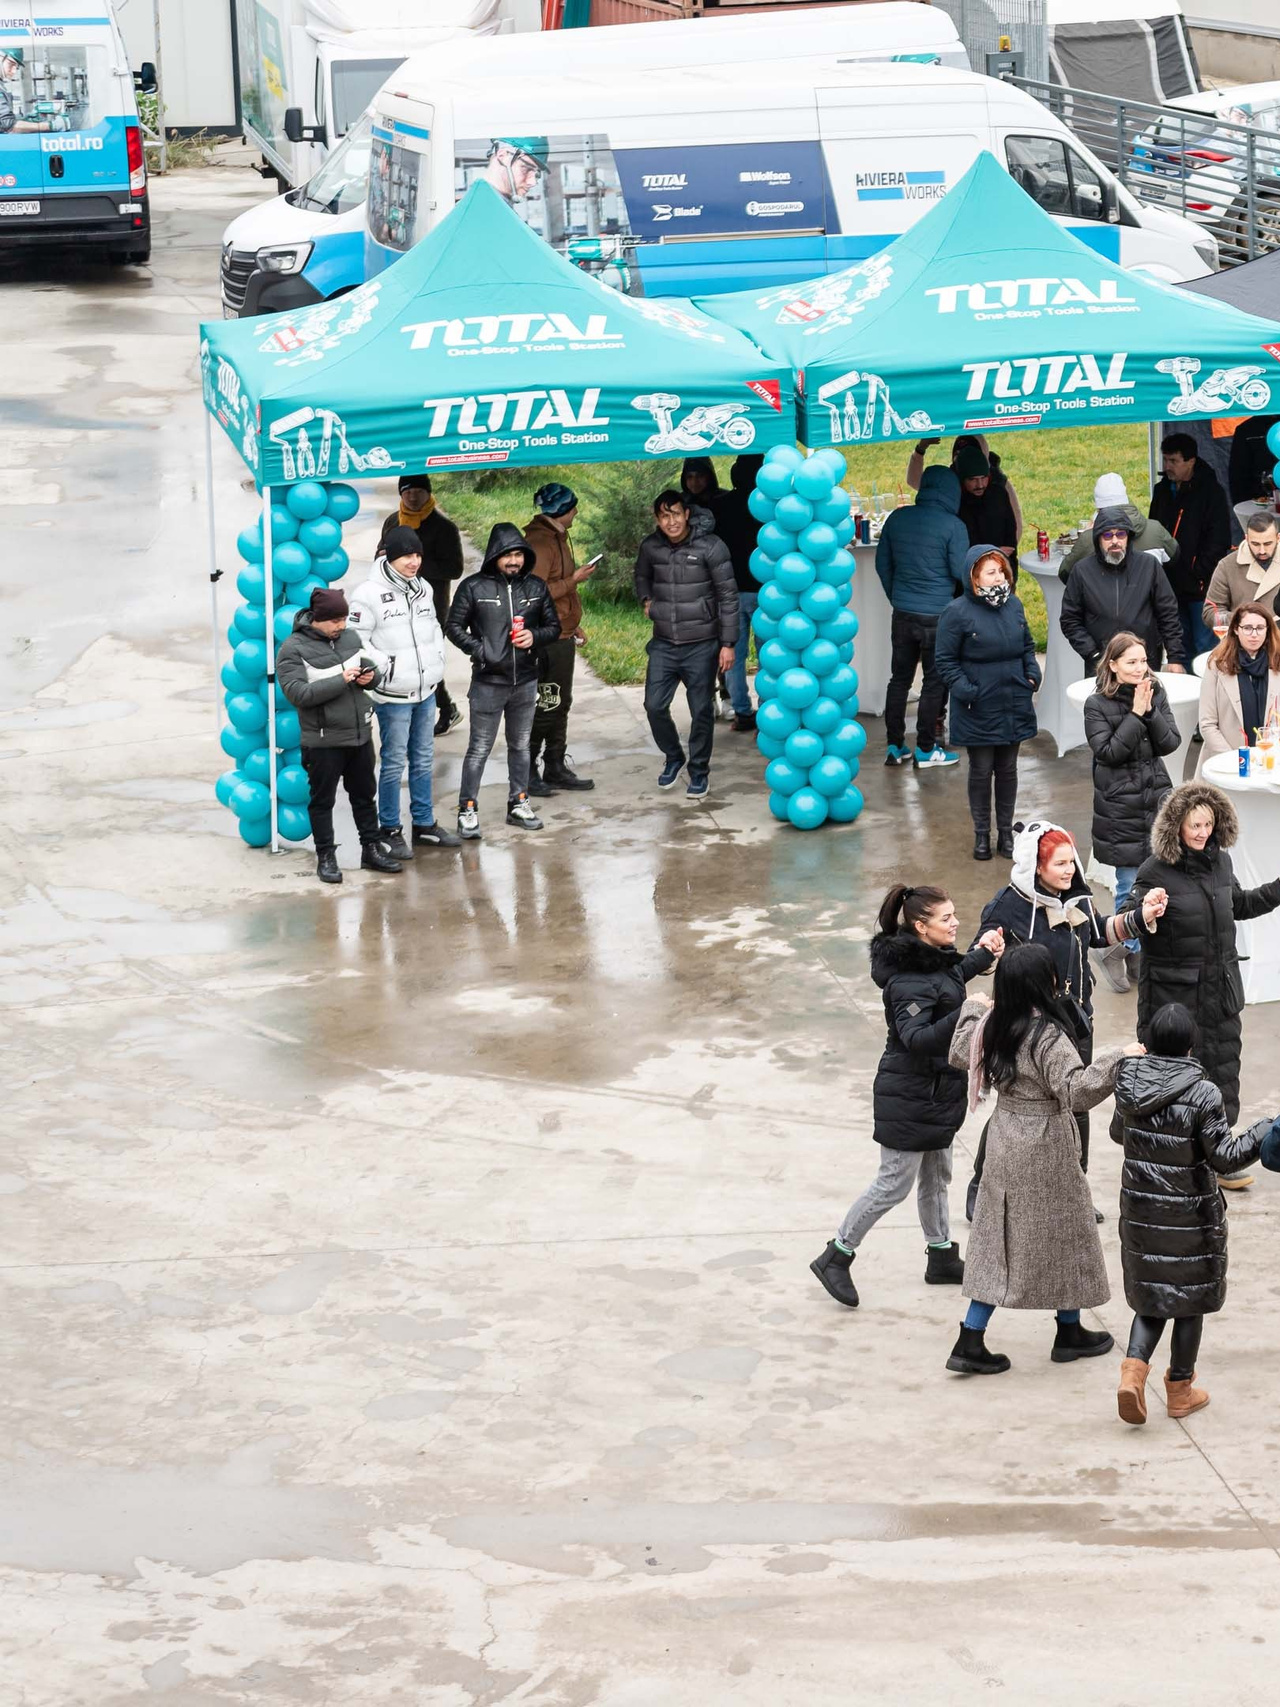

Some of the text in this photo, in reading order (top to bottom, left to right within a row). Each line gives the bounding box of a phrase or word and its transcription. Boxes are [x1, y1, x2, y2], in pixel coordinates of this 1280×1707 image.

[34, 27, 64, 37] WORKS
[41, 134, 103, 152] total.ro
[641, 173, 688, 187] TOTAL
[905, 185, 947, 199] WORKS
[924, 277, 1137, 314] TOTAL
[974, 305, 1141, 321] One-Stop Tools Station
[400, 313, 624, 350] TOTAL
[447, 342, 627, 358] One-Stop Tools Station
[962, 352, 1137, 401] TOTAL
[423, 388, 611, 438] TOTAL
[995, 395, 1135, 414] One-Stop Tools Station
[967, 416, 1040, 428] www.totalbusiness.com
[459, 432, 609, 452] One-Stop Tools Station
[430, 452, 507, 465] www.totalbusiness.com
